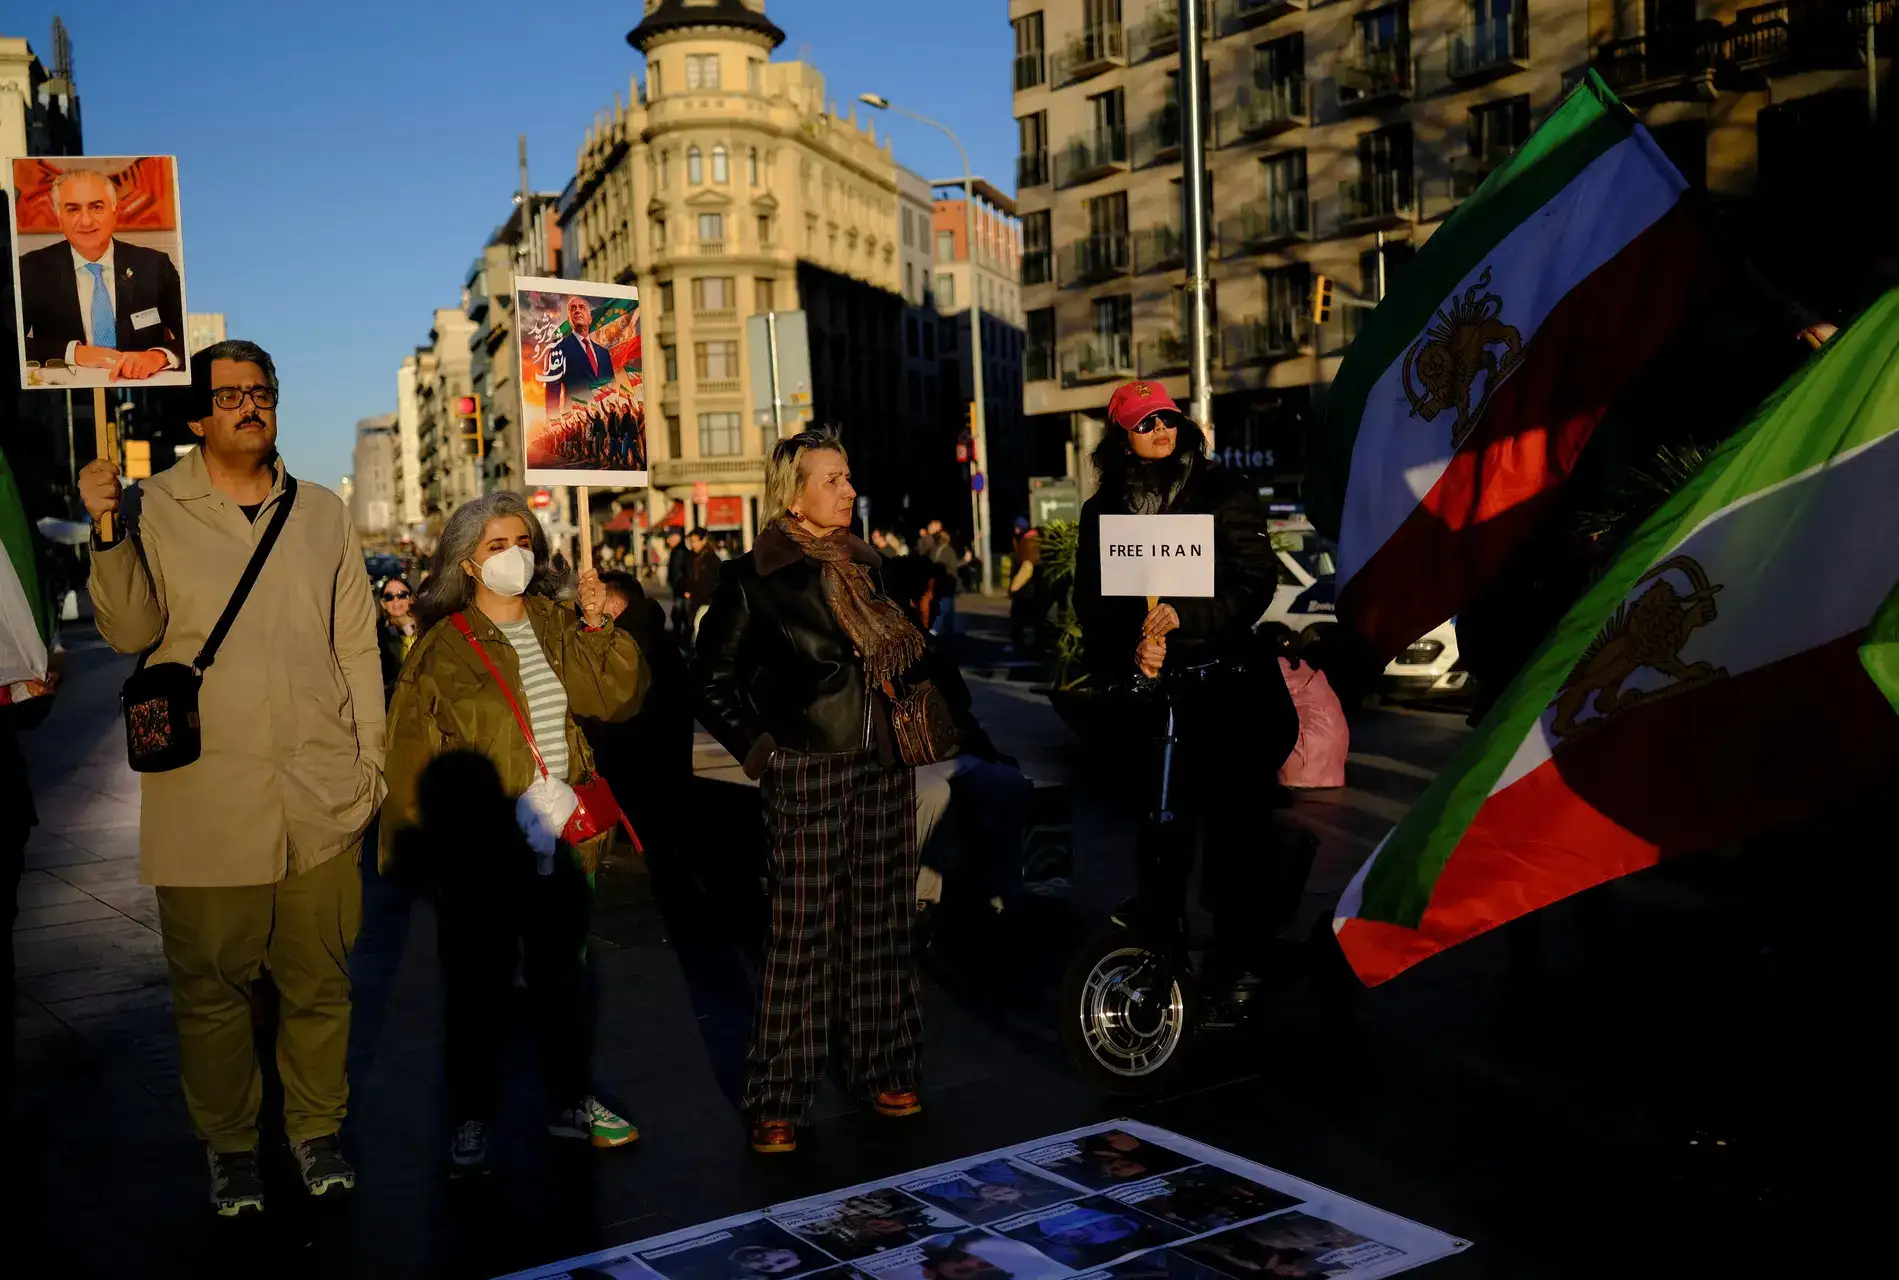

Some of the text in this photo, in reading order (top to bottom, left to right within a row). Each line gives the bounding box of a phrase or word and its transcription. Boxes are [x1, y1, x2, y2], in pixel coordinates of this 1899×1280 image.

[534, 349, 567, 388] انقلاب
[1108, 544, 1202, 558] FREE IRAN
